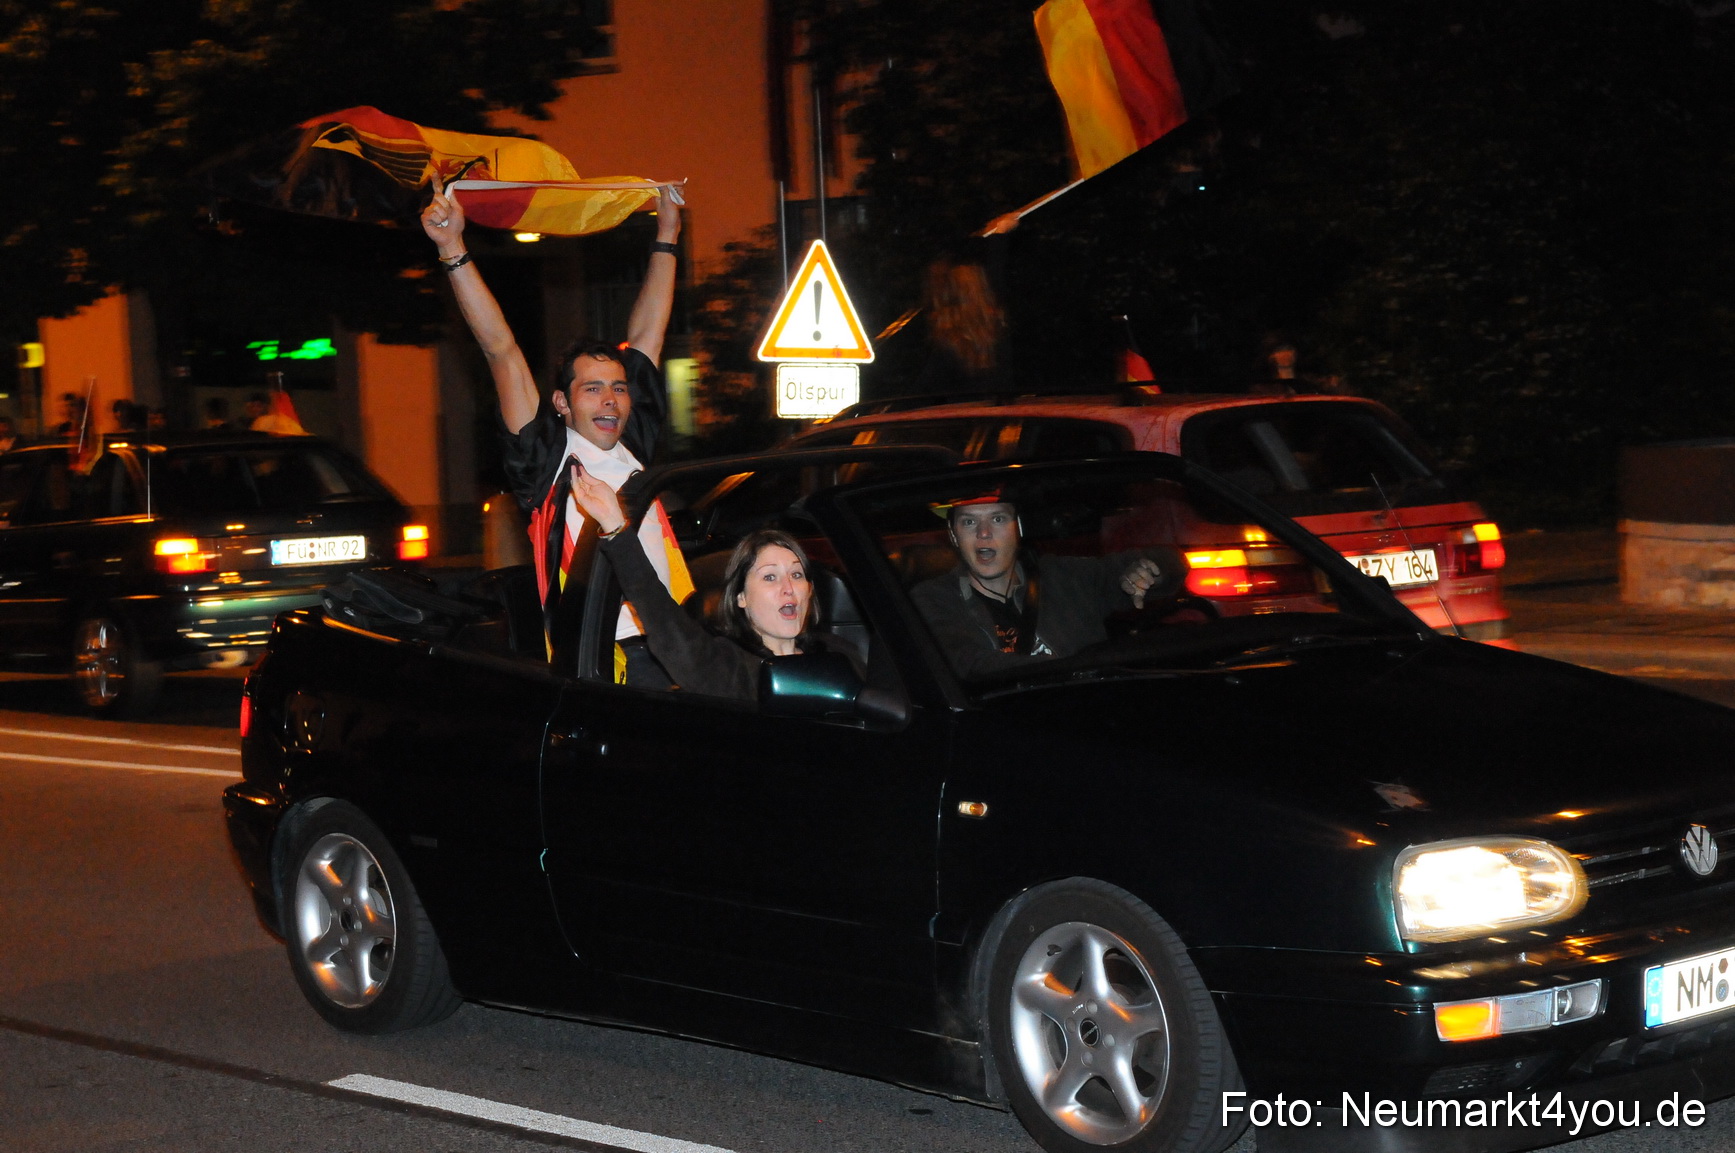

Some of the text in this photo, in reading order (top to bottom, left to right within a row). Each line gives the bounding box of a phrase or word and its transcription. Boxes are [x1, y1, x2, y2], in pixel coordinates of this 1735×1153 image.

[785, 377, 846, 404] Ölspur
[318, 541, 336, 557] NR
[342, 539, 359, 556] 92
[1404, 553, 1433, 578] 164
[1677, 962, 1714, 1012] NM
